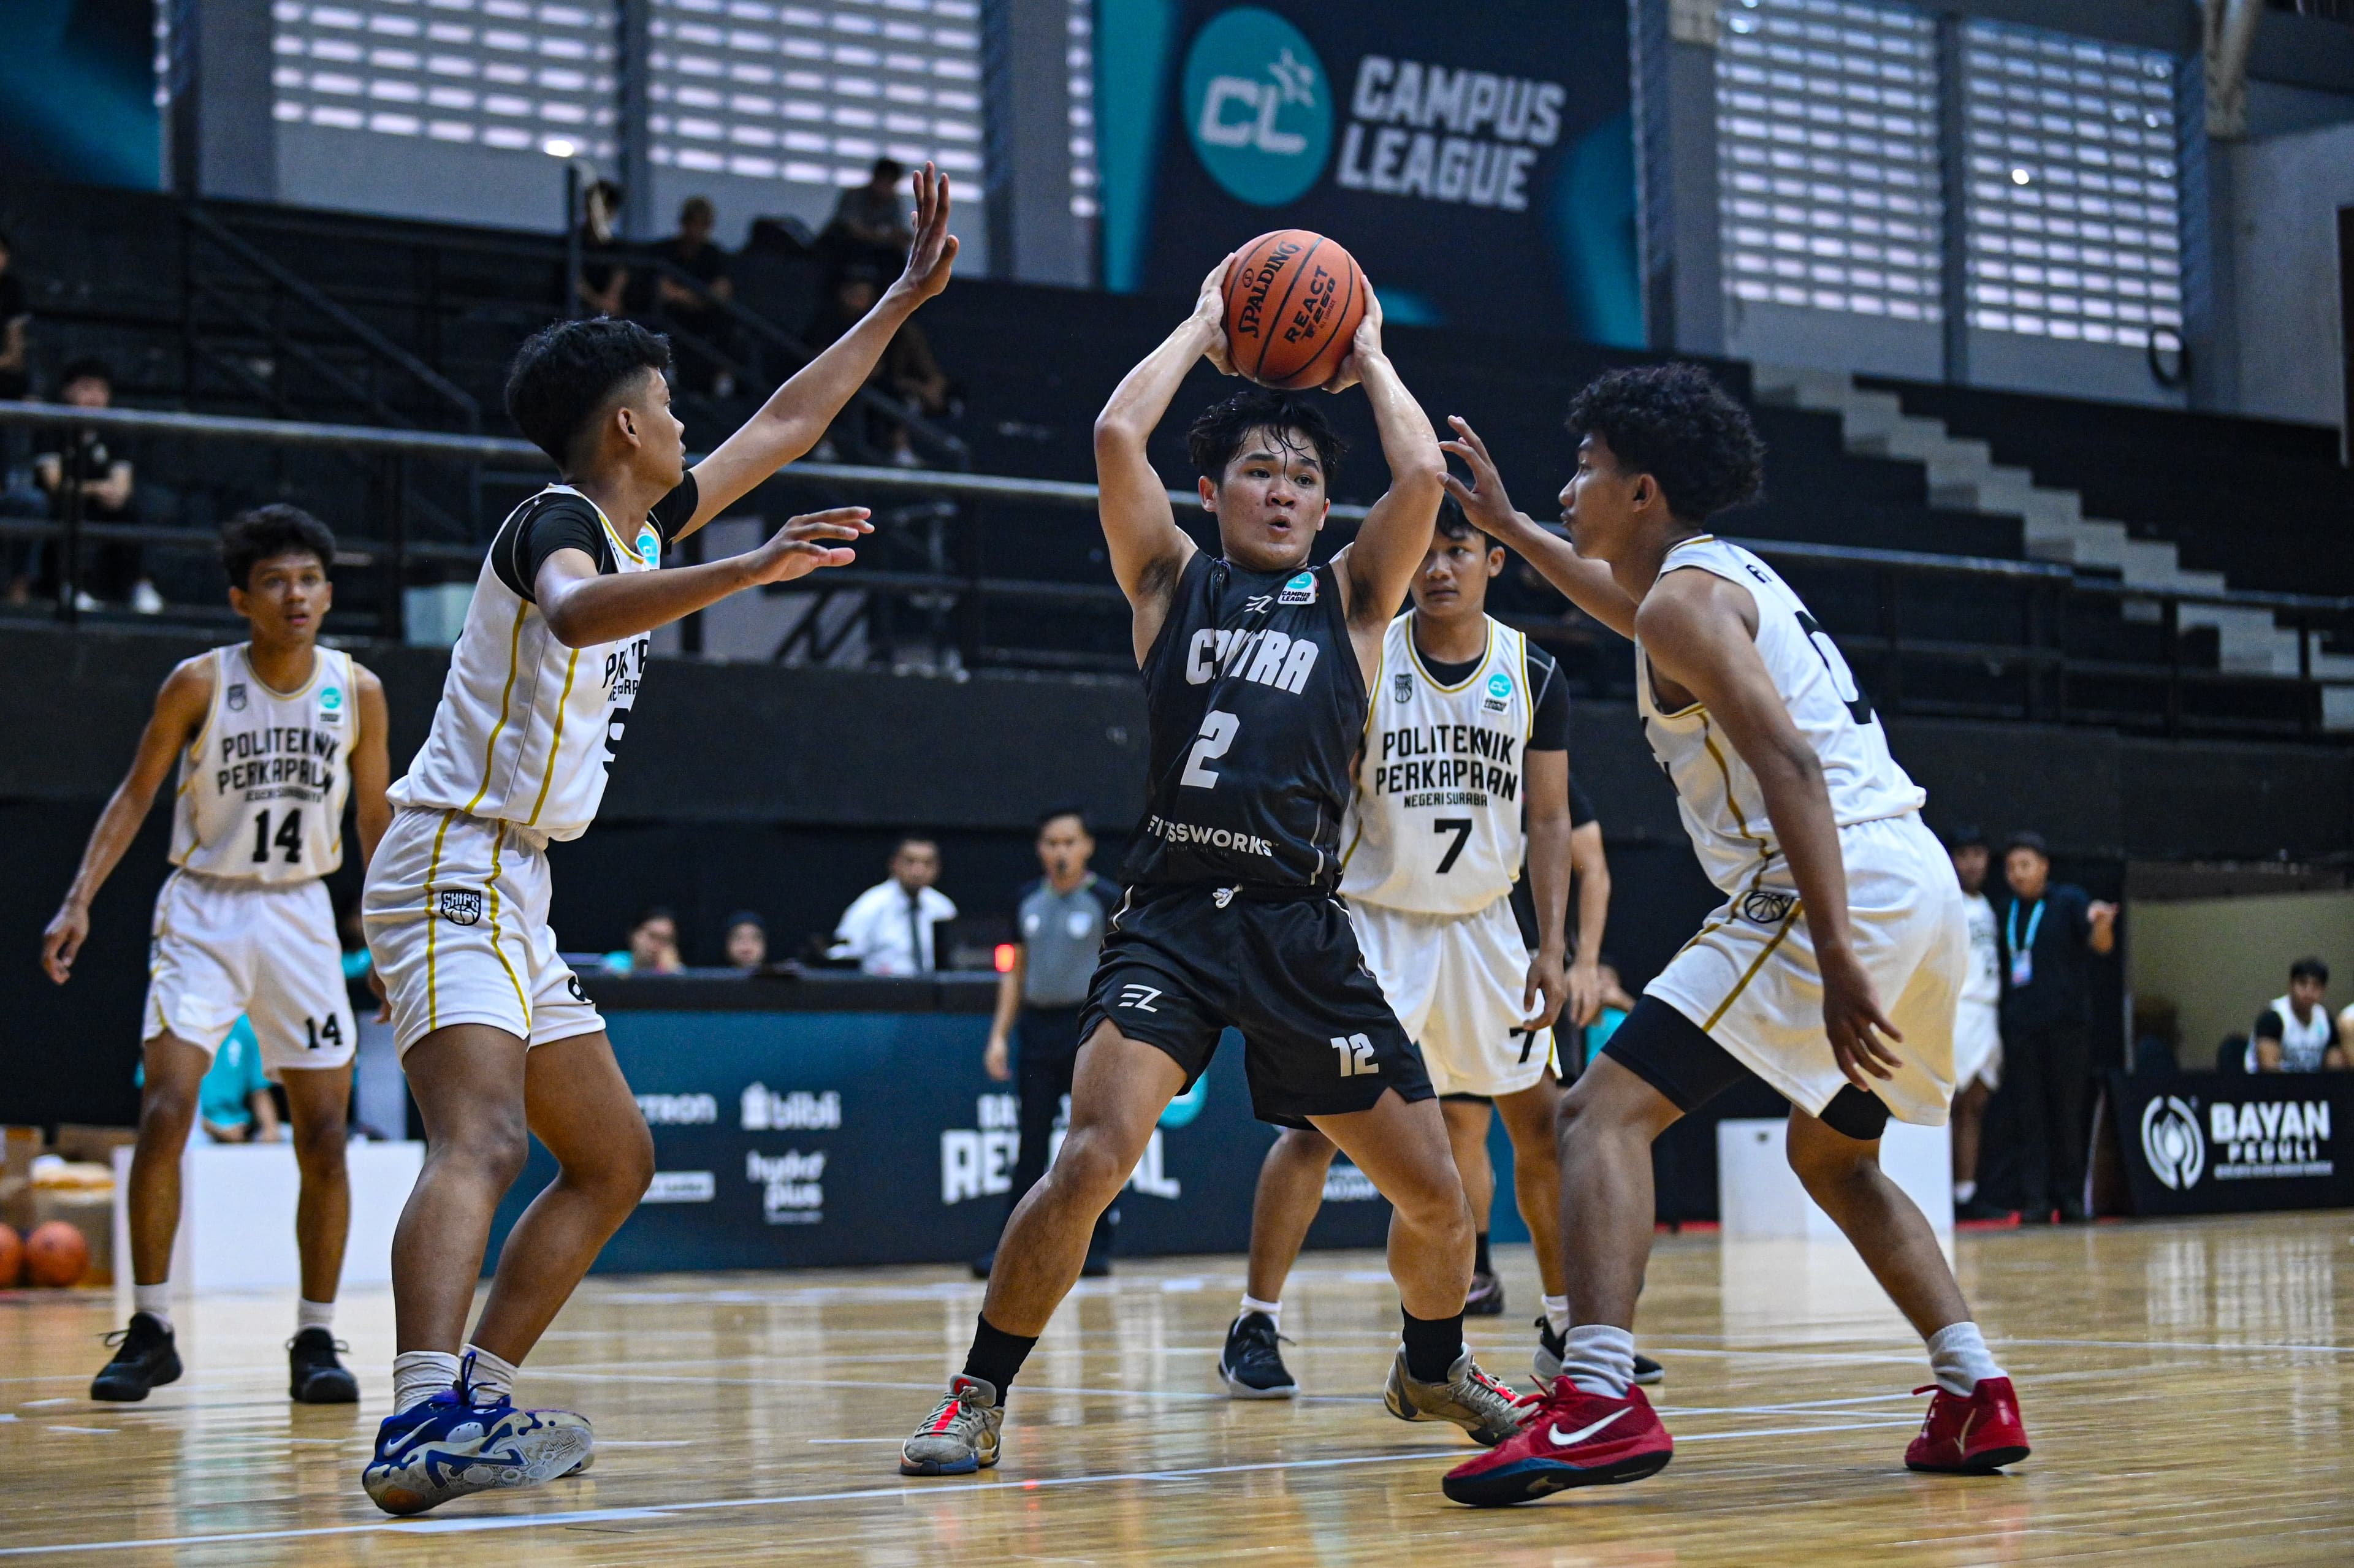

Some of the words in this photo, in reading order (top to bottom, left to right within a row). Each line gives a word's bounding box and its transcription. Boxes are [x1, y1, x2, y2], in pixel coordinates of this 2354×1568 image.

[1199, 76, 1306, 154] CL
[1354, 55, 1566, 147] CAMPUS
[1336, 123, 1537, 212] LEAGUE
[1238, 241, 1300, 338] SPALDING
[1283, 264, 1328, 343] REACT
[1382, 725, 1515, 766] POLITEKNIK
[1404, 794, 1444, 808] NEGERI
[252, 808, 303, 863] 14
[1434, 818, 1472, 874] 7
[443, 892, 479, 912] SHIPS
[305, 1012, 343, 1049] 14
[1330, 1033, 1379, 1078] 12
[1509, 1027, 1536, 1064] 7
[2211, 1101, 2330, 1144] BAYAN
